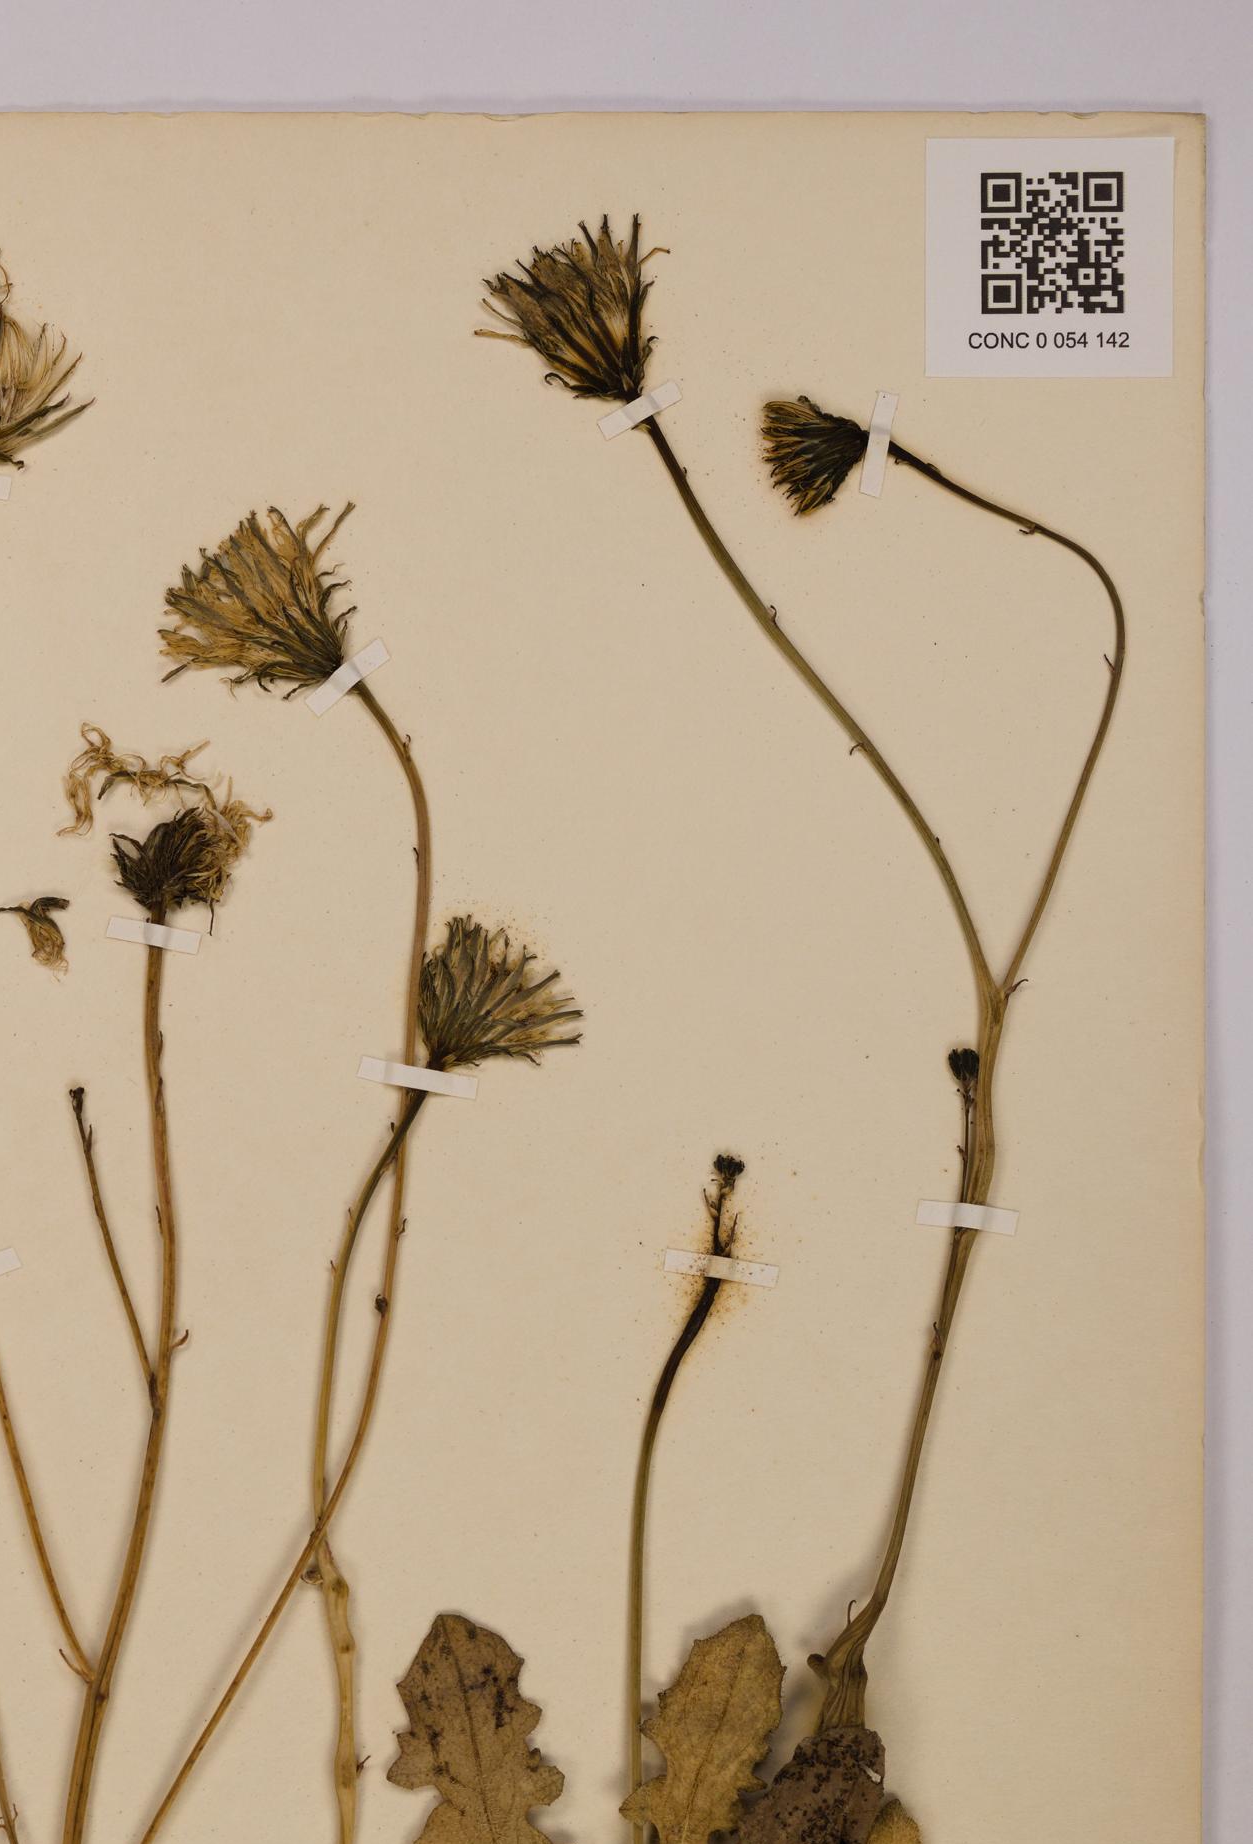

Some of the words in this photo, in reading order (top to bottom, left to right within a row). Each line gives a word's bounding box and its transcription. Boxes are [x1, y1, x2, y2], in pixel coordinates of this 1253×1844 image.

[968, 332, 1030, 350] CONC
[1035, 332, 1048, 349] 0
[1053, 331, 1089, 349] 054
[1096, 331, 1130, 348] 142
